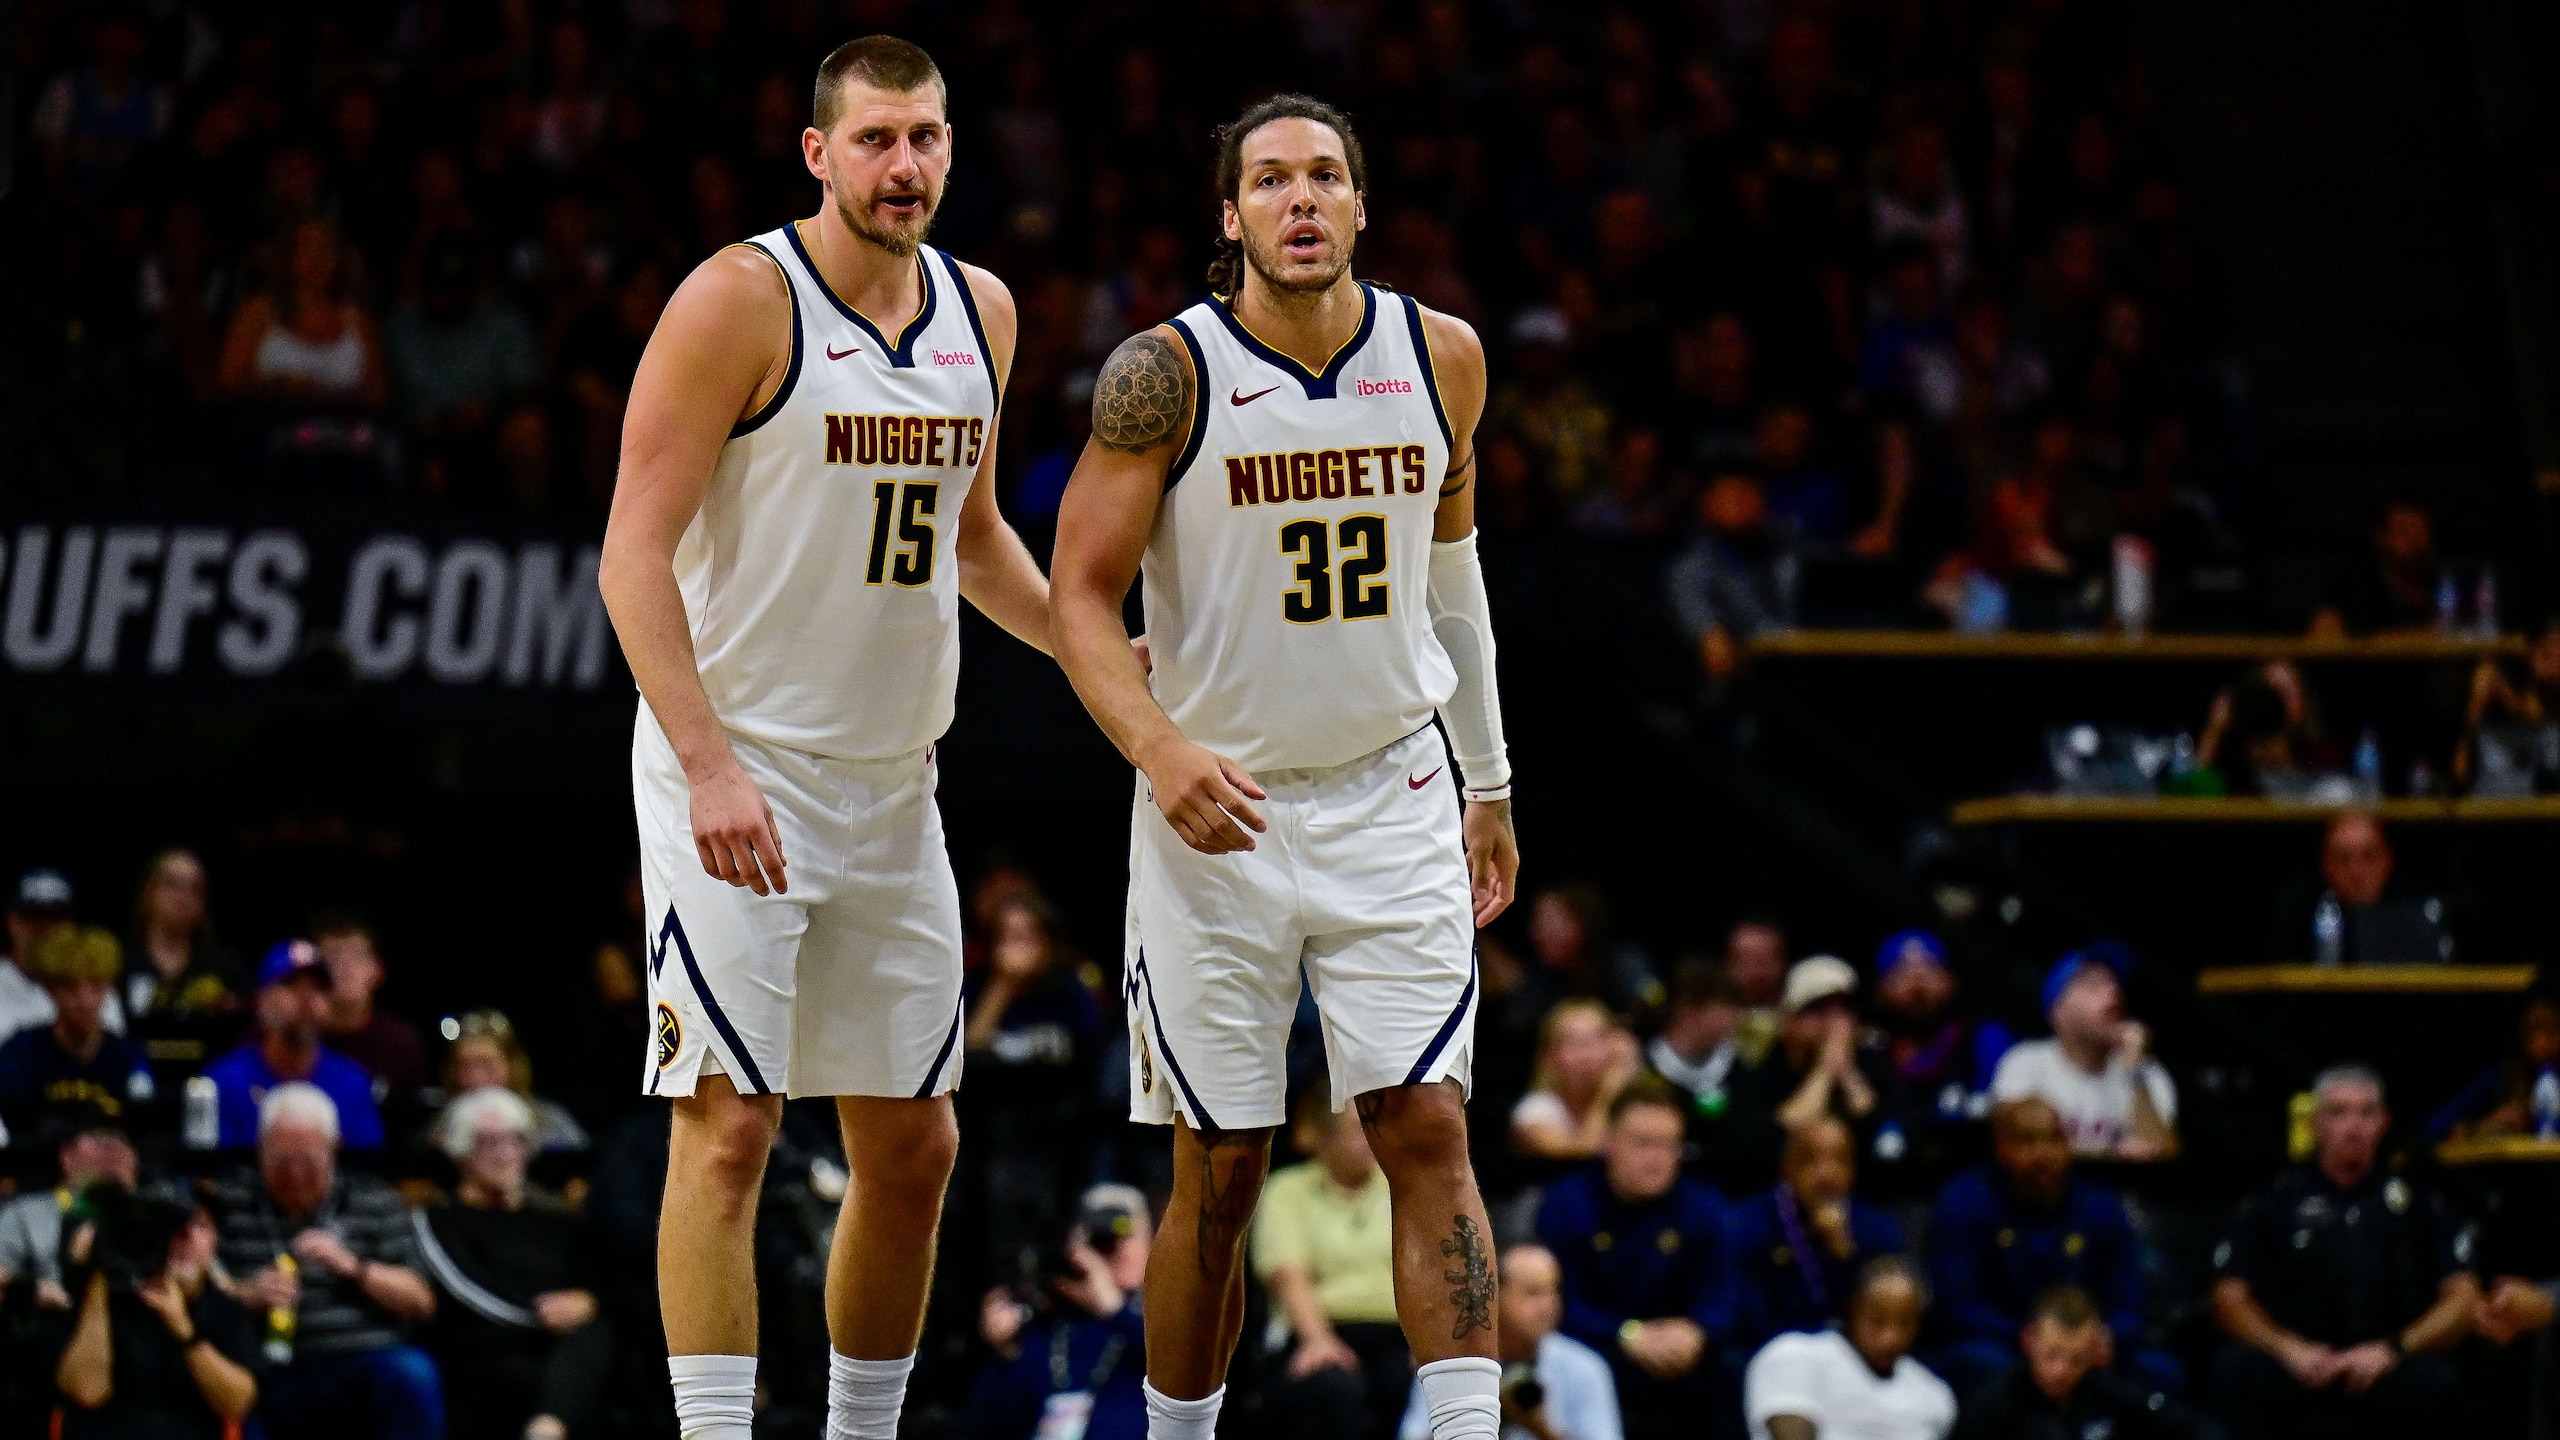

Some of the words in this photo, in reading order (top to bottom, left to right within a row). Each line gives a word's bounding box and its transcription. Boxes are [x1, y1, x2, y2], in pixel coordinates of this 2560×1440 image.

[932, 350, 976, 366] ibotta
[1357, 379, 1412, 396] ibotta
[824, 413, 984, 468] NUGGETS
[1224, 443, 1425, 508] NUGGETS
[864, 479, 941, 588] 15
[0, 522, 311, 679] UFFS
[1279, 511, 1391, 626] 32
